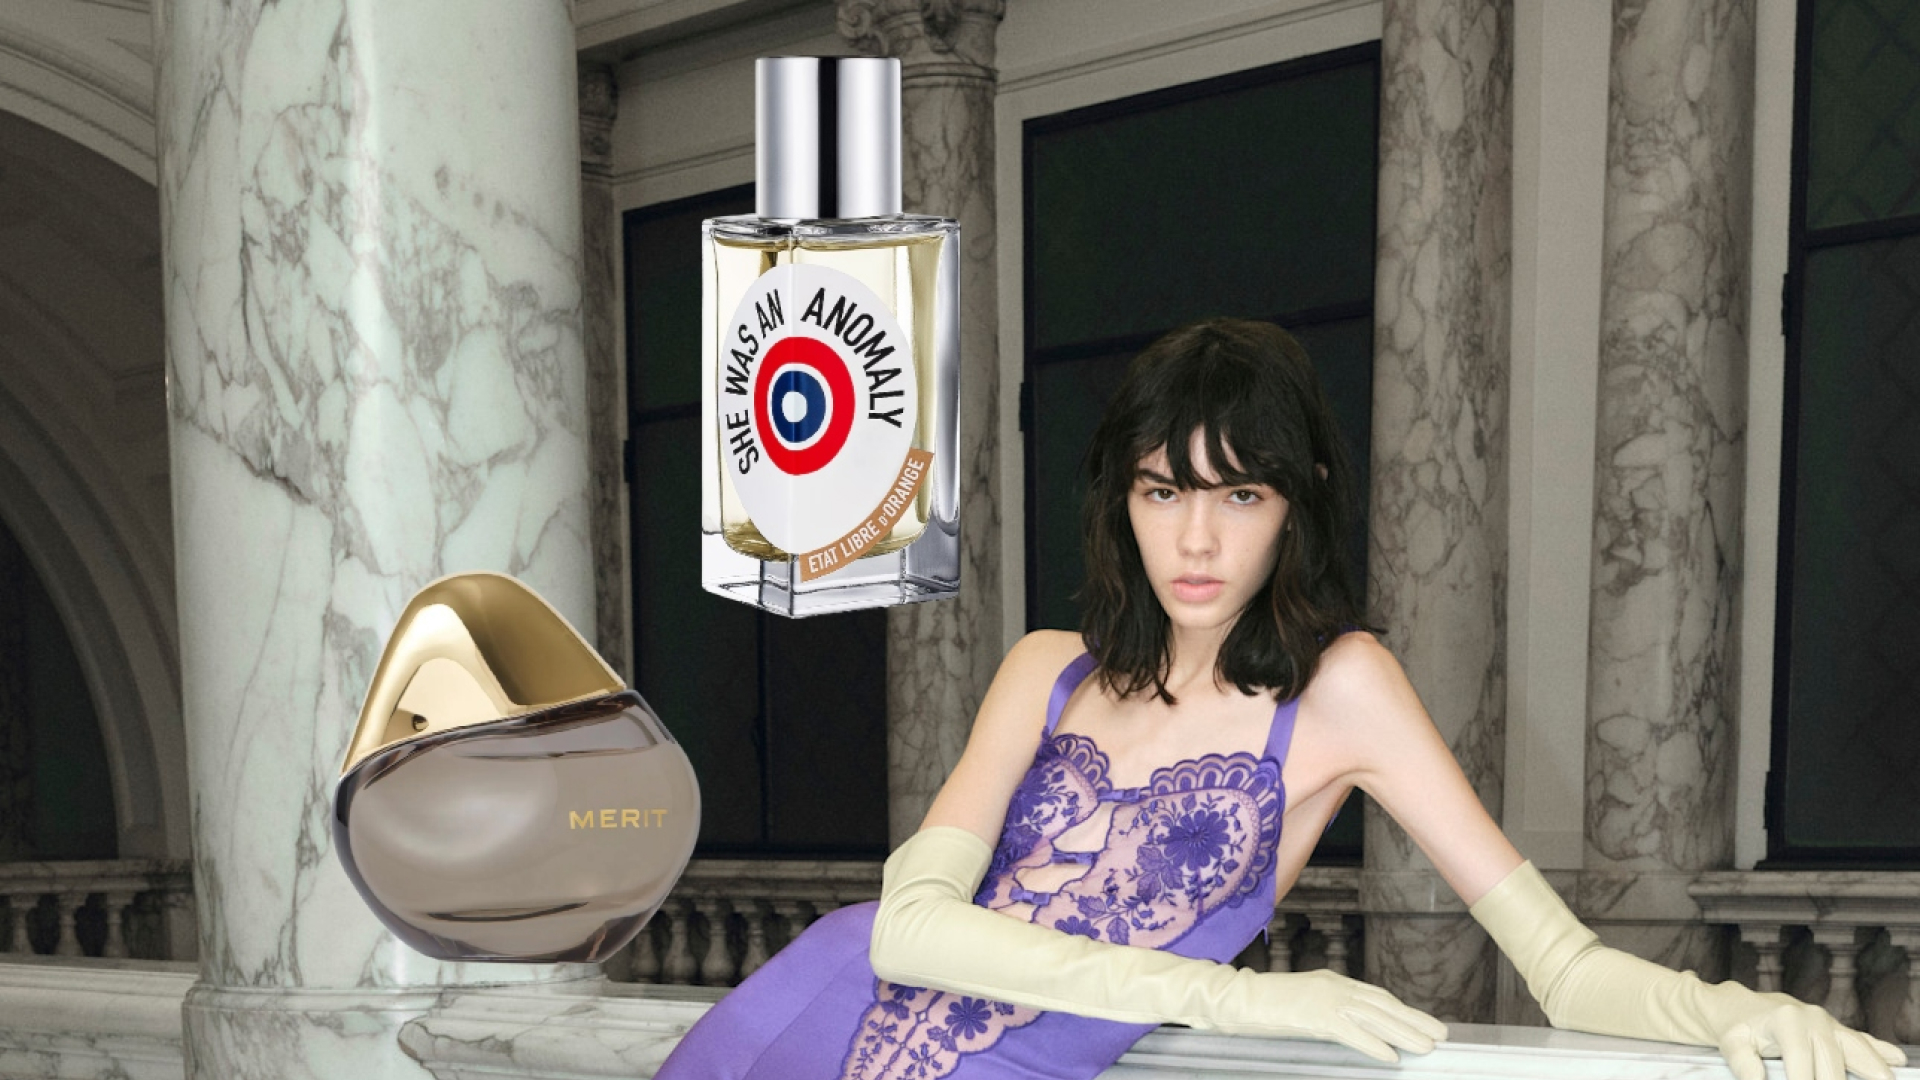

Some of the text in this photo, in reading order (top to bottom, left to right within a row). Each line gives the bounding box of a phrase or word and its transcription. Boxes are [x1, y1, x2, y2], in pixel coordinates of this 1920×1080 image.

[725, 287, 905, 475] SHE WAS AN ANOMALY
[808, 546, 839, 573] ETAT
[840, 520, 880, 558] LIBRE
[569, 809, 668, 829] MERIT
